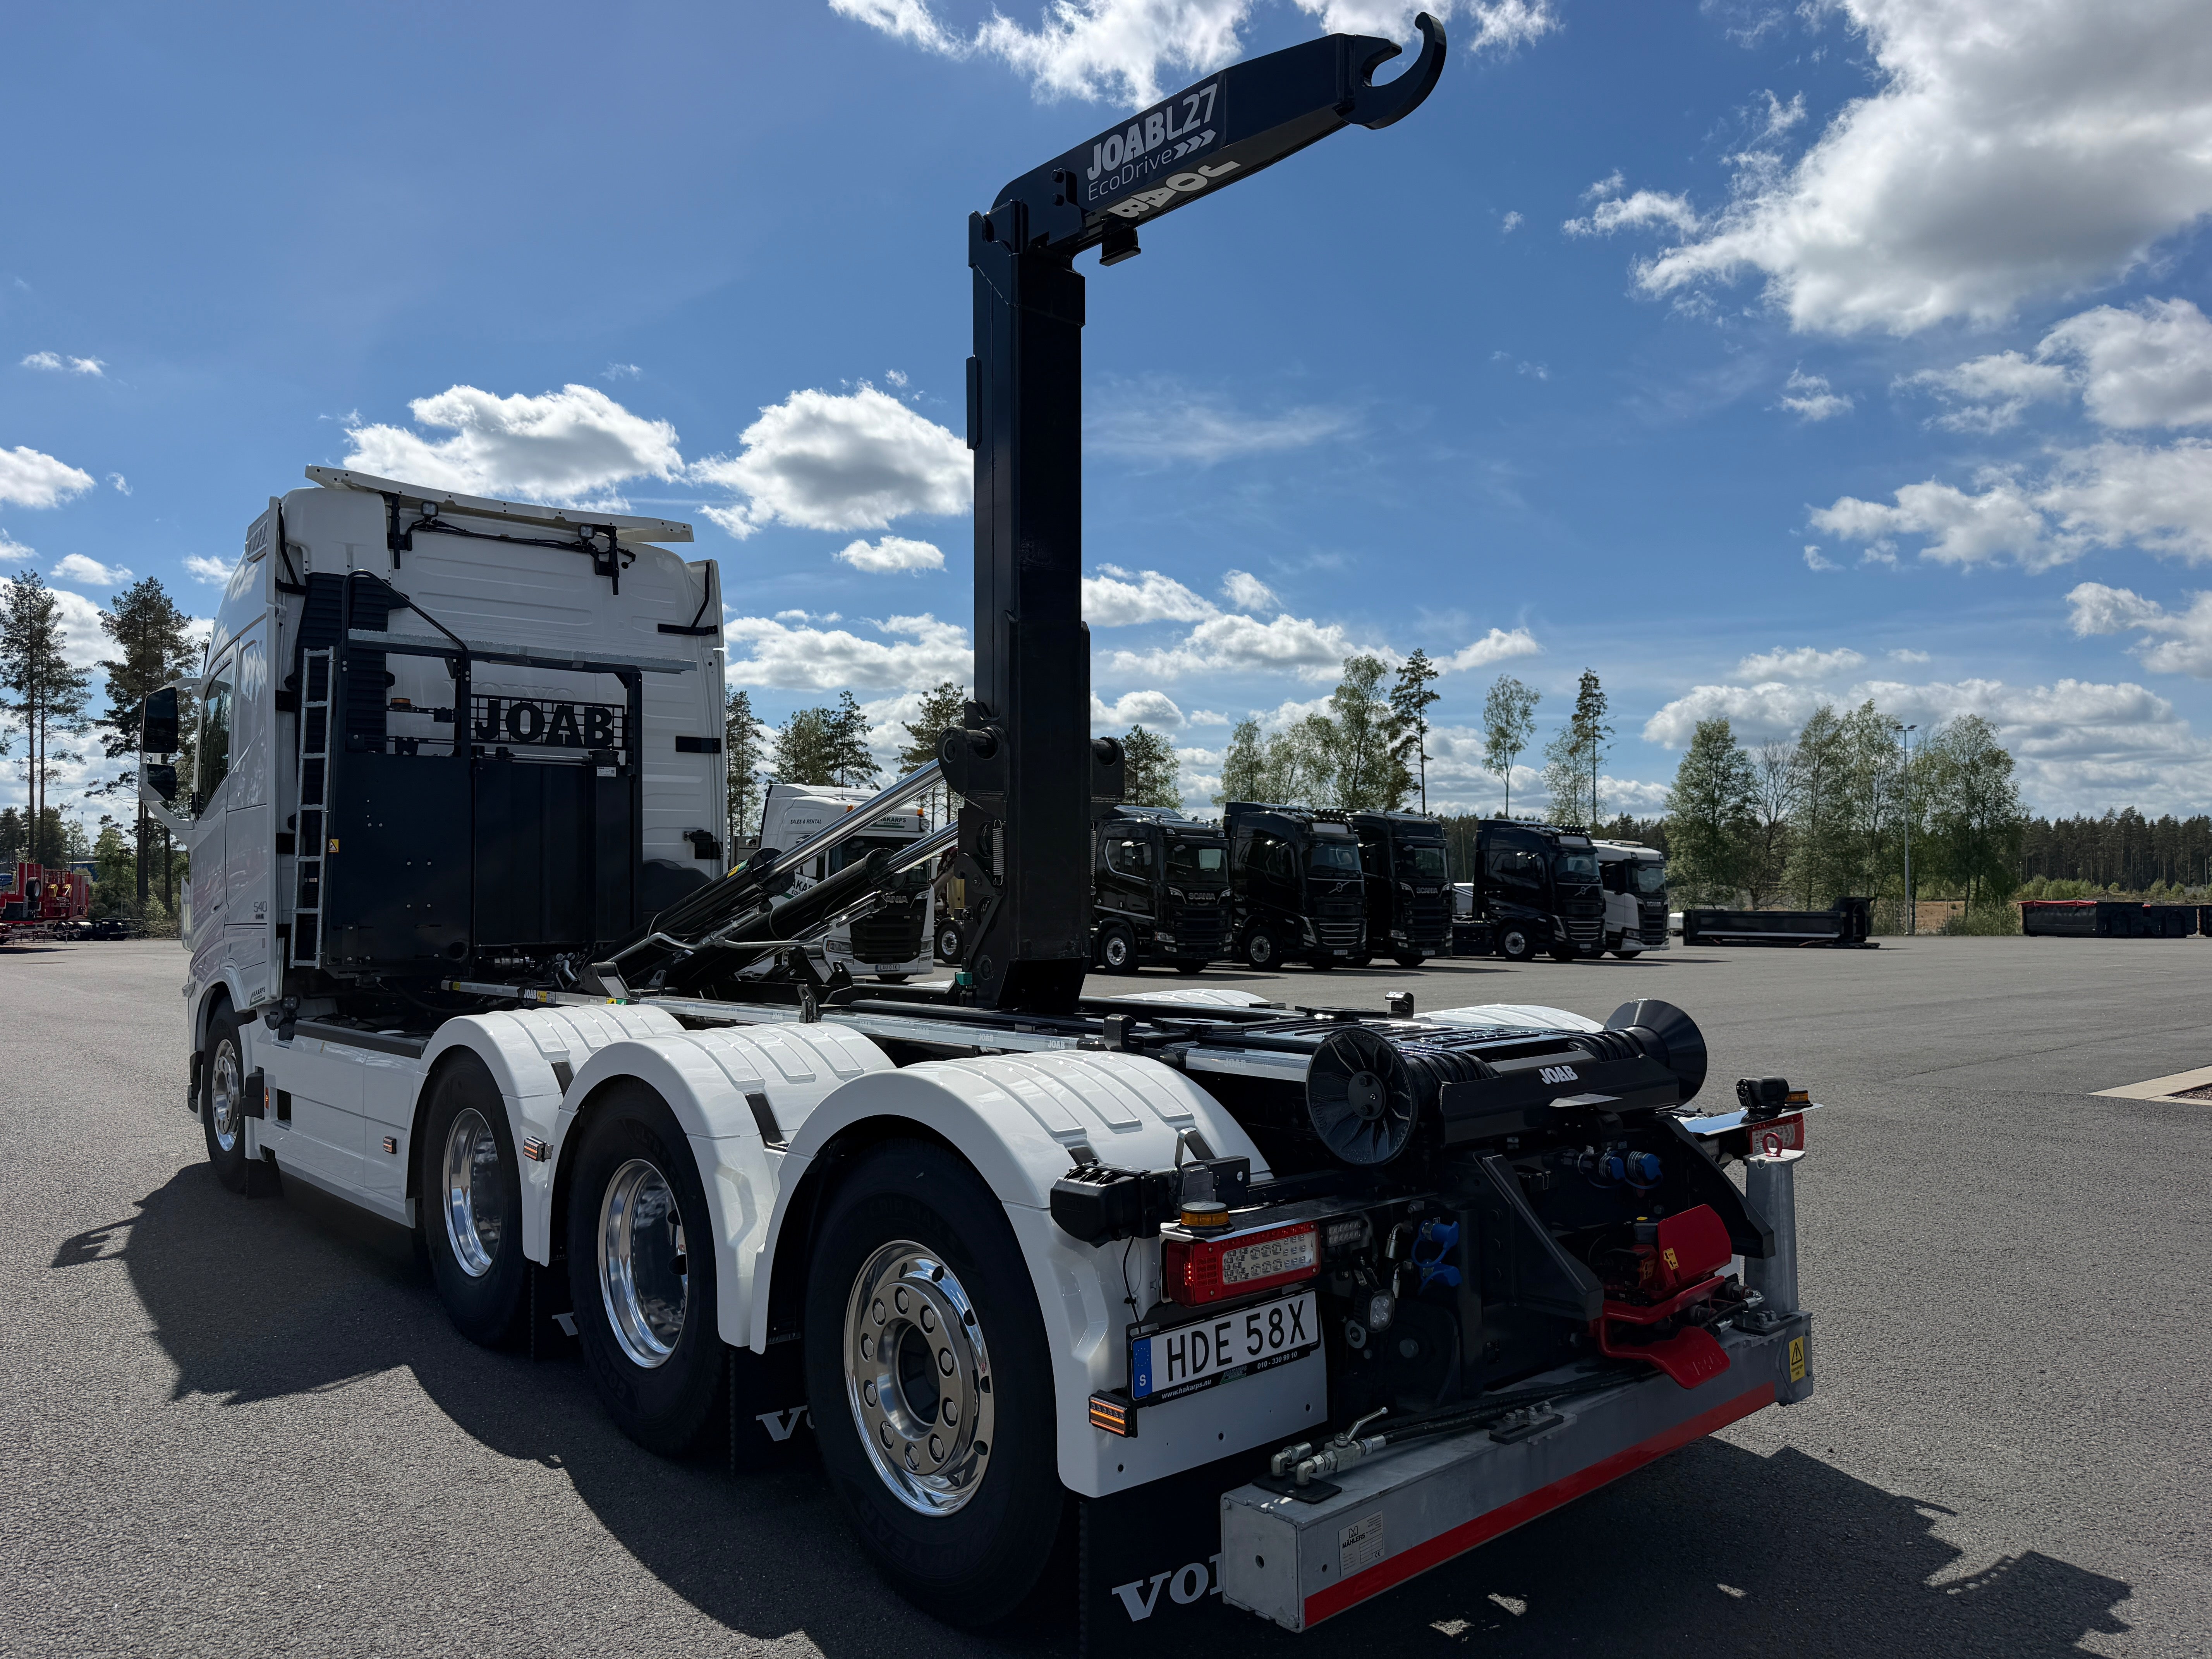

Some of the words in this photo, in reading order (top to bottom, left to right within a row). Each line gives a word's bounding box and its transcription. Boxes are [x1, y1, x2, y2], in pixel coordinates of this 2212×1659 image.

[1088, 148, 1172, 201] EcoDrive
[1107, 161, 1241, 218] JOAB
[474, 699, 613, 748] JOAB
[254, 901, 267, 912] 540
[524, 988, 537, 1000] JOAB
[1048, 1040, 1065, 1049] JOAB
[1224, 1058, 1246, 1068] JOAB
[1539, 1065, 1578, 1084] JOAB
[1167, 1321, 1232, 1382] HDE
[1246, 1300, 1306, 1355] 58X
[1139, 1374, 1146, 1387] S
[1161, 1379, 1211, 1399] www.hakarps.nu
[1342, 1532, 1365, 1549] MÄHLERS
